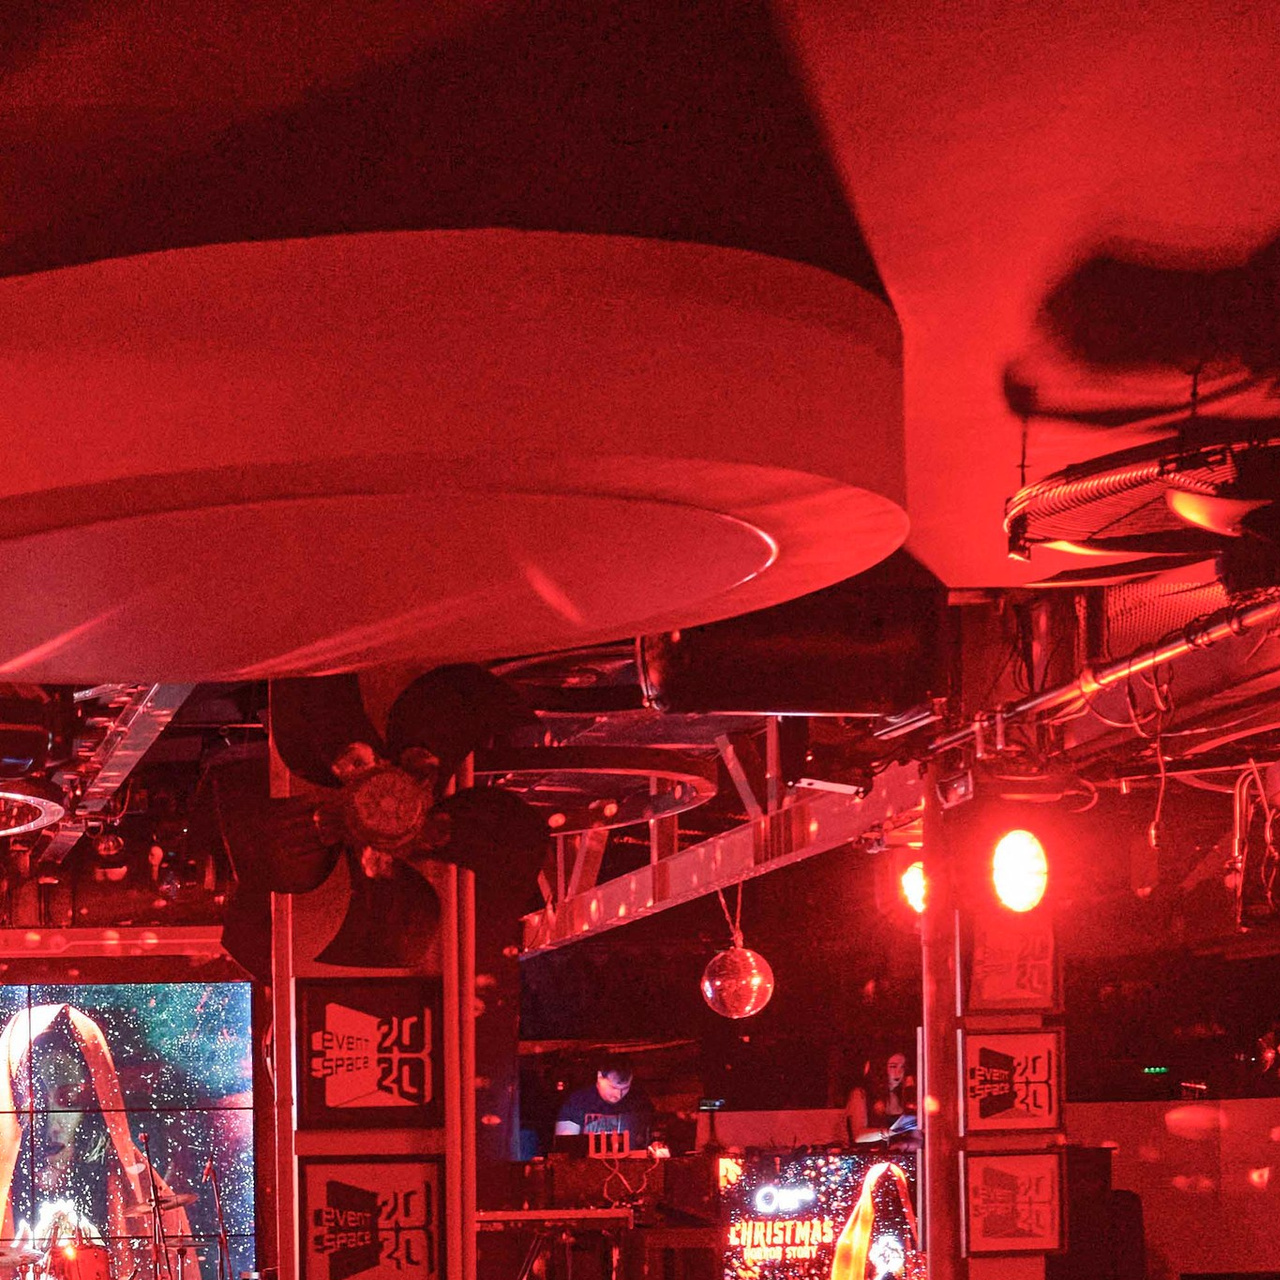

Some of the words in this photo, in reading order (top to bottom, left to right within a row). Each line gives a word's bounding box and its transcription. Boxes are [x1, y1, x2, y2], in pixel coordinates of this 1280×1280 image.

[378, 1008, 426, 1053] 20
[378, 1057, 426, 1104] 20
[322, 1207, 372, 1228] event
[380, 1184, 428, 1229] 20
[323, 1231, 371, 1256] space
[380, 1230, 430, 1274] 20
[729, 1220, 835, 1248] CHRISTMAS
[785, 1245, 819, 1260] STORY
